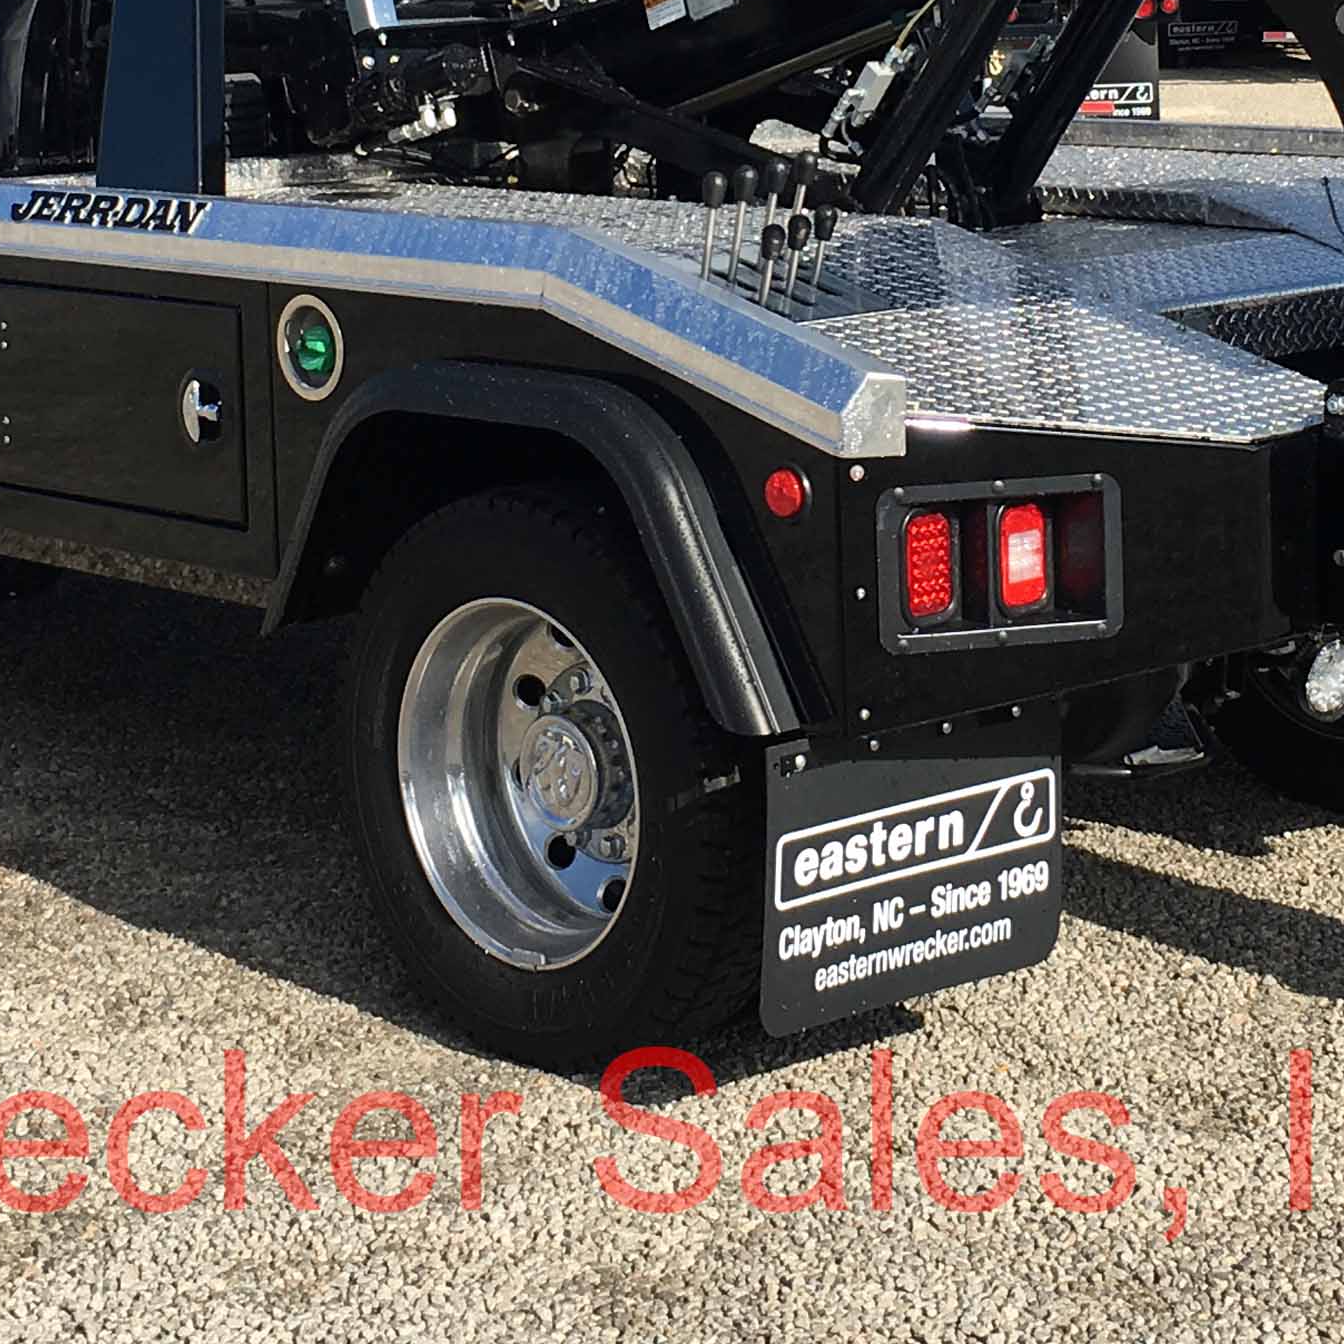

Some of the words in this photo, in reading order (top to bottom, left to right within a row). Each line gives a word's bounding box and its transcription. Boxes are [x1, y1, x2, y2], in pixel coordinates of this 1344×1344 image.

[793, 809, 964, 887] eastern
[778, 913, 866, 960] Clayton,
[872, 895, 904, 934] NC
[930, 879, 991, 918] Since
[997, 860, 1049, 901] 1969
[814, 916, 1012, 992] easternwrecker.com
